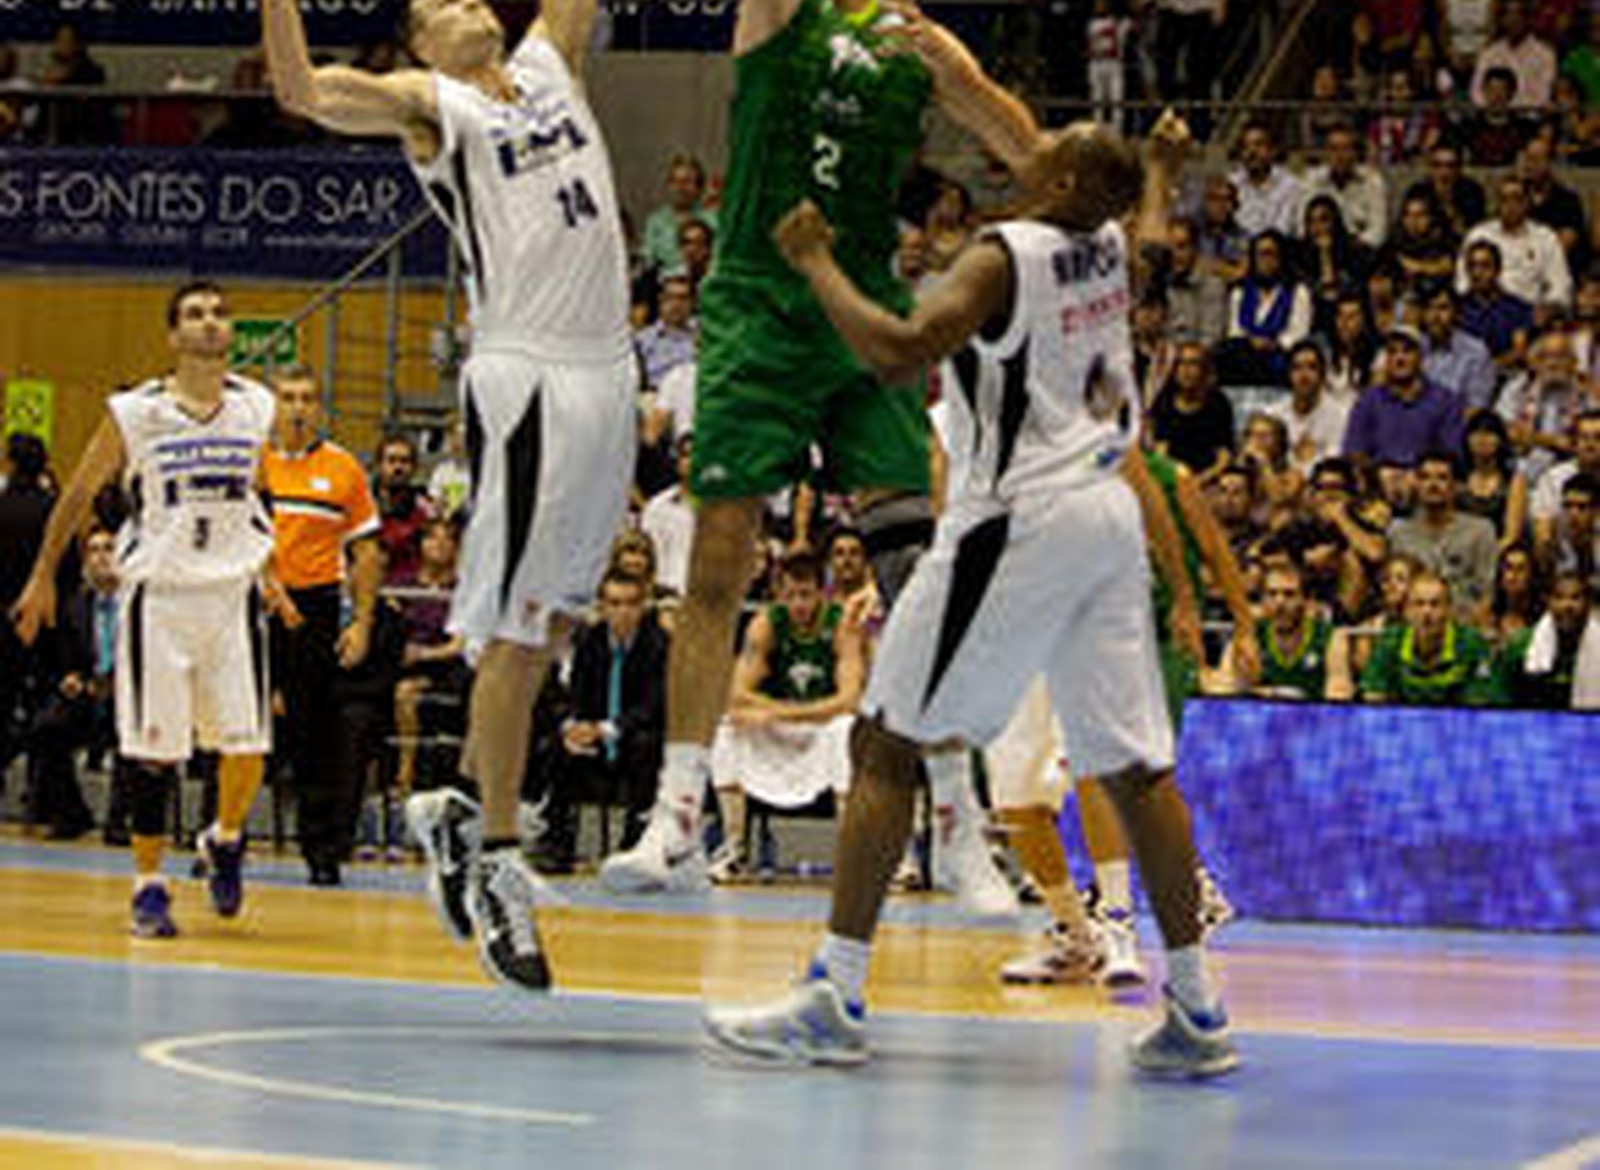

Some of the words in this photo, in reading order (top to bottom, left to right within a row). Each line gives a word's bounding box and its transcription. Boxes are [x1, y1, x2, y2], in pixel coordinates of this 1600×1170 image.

[811, 131, 843, 192] 2
[37, 168, 206, 224] FONTES
[217, 172, 303, 226] DO
[313, 173, 402, 228] SAR
[556, 178, 599, 228] 14
